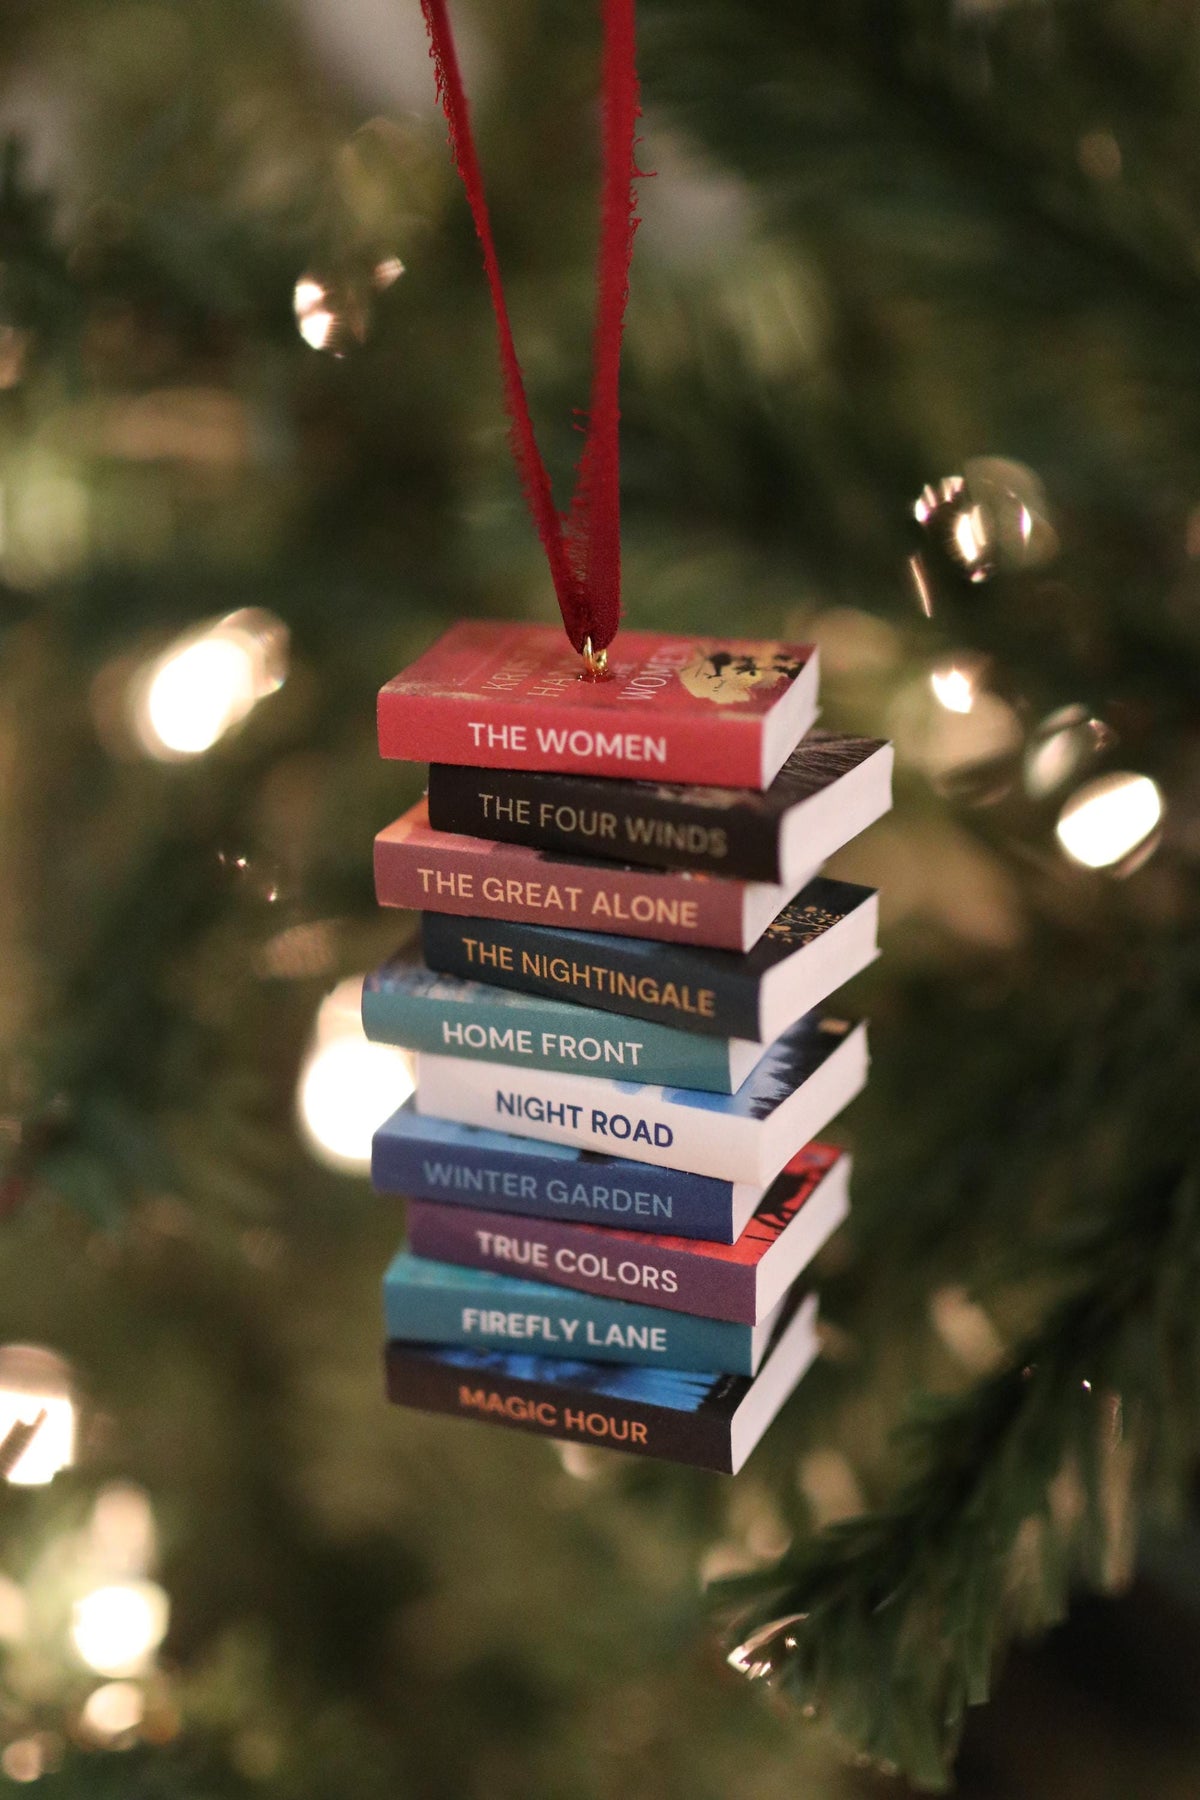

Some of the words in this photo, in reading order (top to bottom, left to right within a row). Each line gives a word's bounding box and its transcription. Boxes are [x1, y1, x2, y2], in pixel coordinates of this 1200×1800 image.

[468, 722, 528, 751] THE
[536, 727, 667, 764] WOMEN
[478, 792, 531, 826] THE
[540, 803, 618, 840] FOUR
[624, 816, 729, 859] WINDS
[417, 868, 474, 898] THE
[482, 876, 584, 912] GREAT
[591, 891, 699, 928] ALONE
[462, 937, 515, 972] THE
[522, 951, 716, 1018] NIGHTINGALE
[442, 1020, 533, 1054] HOME
[542, 1032, 643, 1066] FRONT
[496, 1090, 584, 1129] NIGHT
[591, 1110, 674, 1148] ROAD
[422, 1160, 537, 1198] WINTER
[546, 1179, 673, 1218] GARDEN
[476, 1230, 549, 1268] TRUE
[555, 1248, 679, 1293] COLORS
[462, 1307, 579, 1343] FIREFLY
[587, 1320, 667, 1352] LANE
[458, 1385, 557, 1427] MAGIC
[564, 1407, 649, 1444] HOUR
